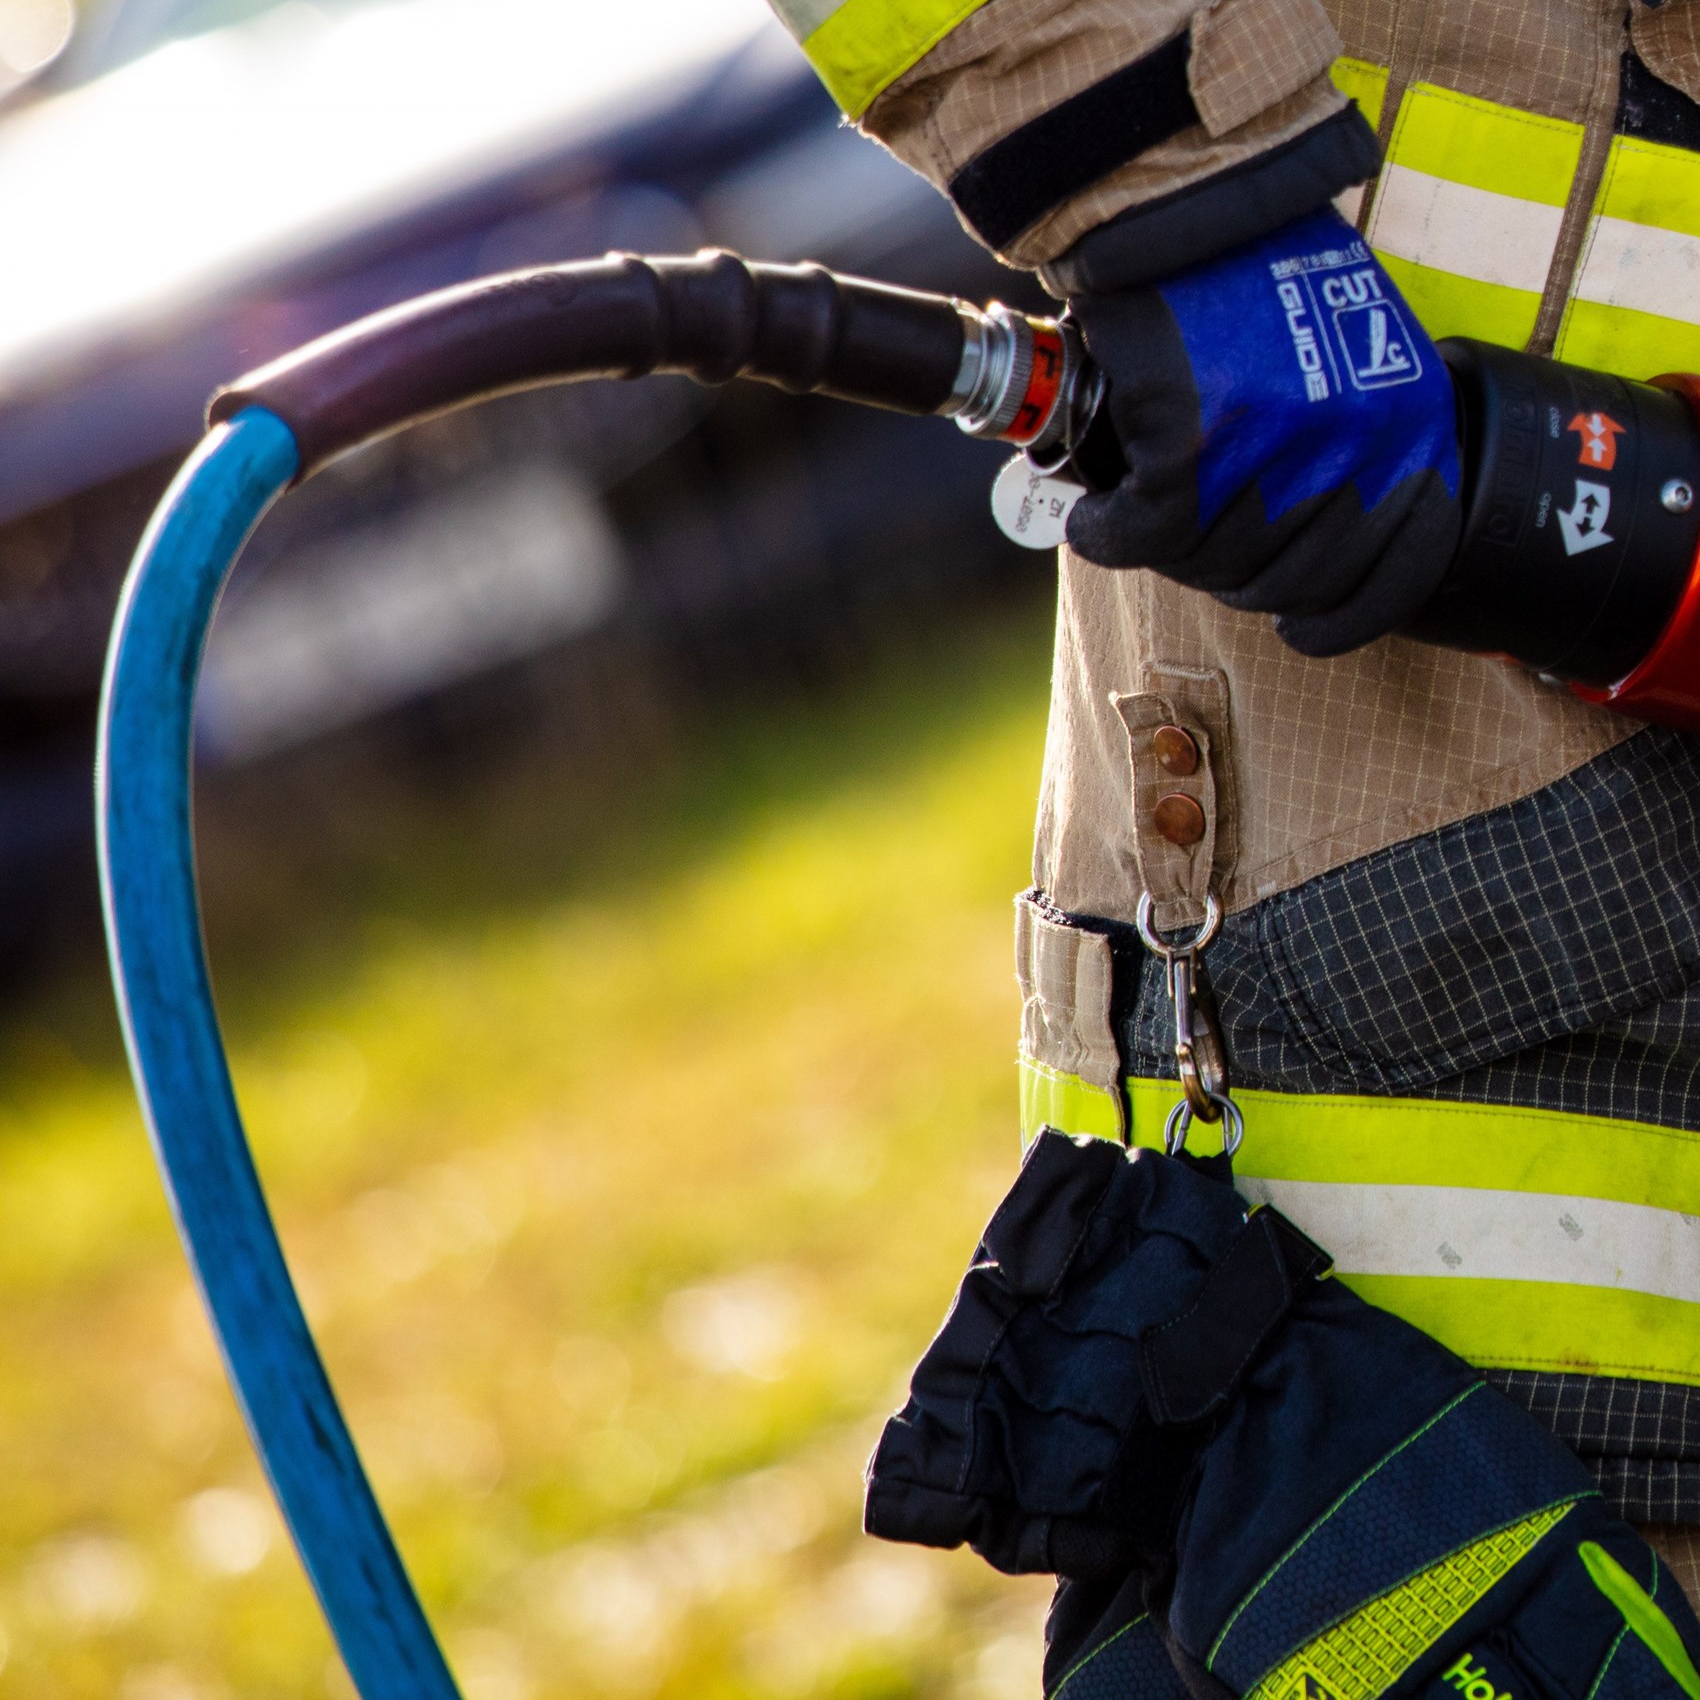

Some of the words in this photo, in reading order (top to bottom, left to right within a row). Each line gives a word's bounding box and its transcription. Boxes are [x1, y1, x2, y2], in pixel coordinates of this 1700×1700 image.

[1326, 269, 1381, 306] CUT
[1277, 281, 1330, 403] GUIDE
[1547, 405, 1561, 439] close
[1535, 492, 1551, 527] open
